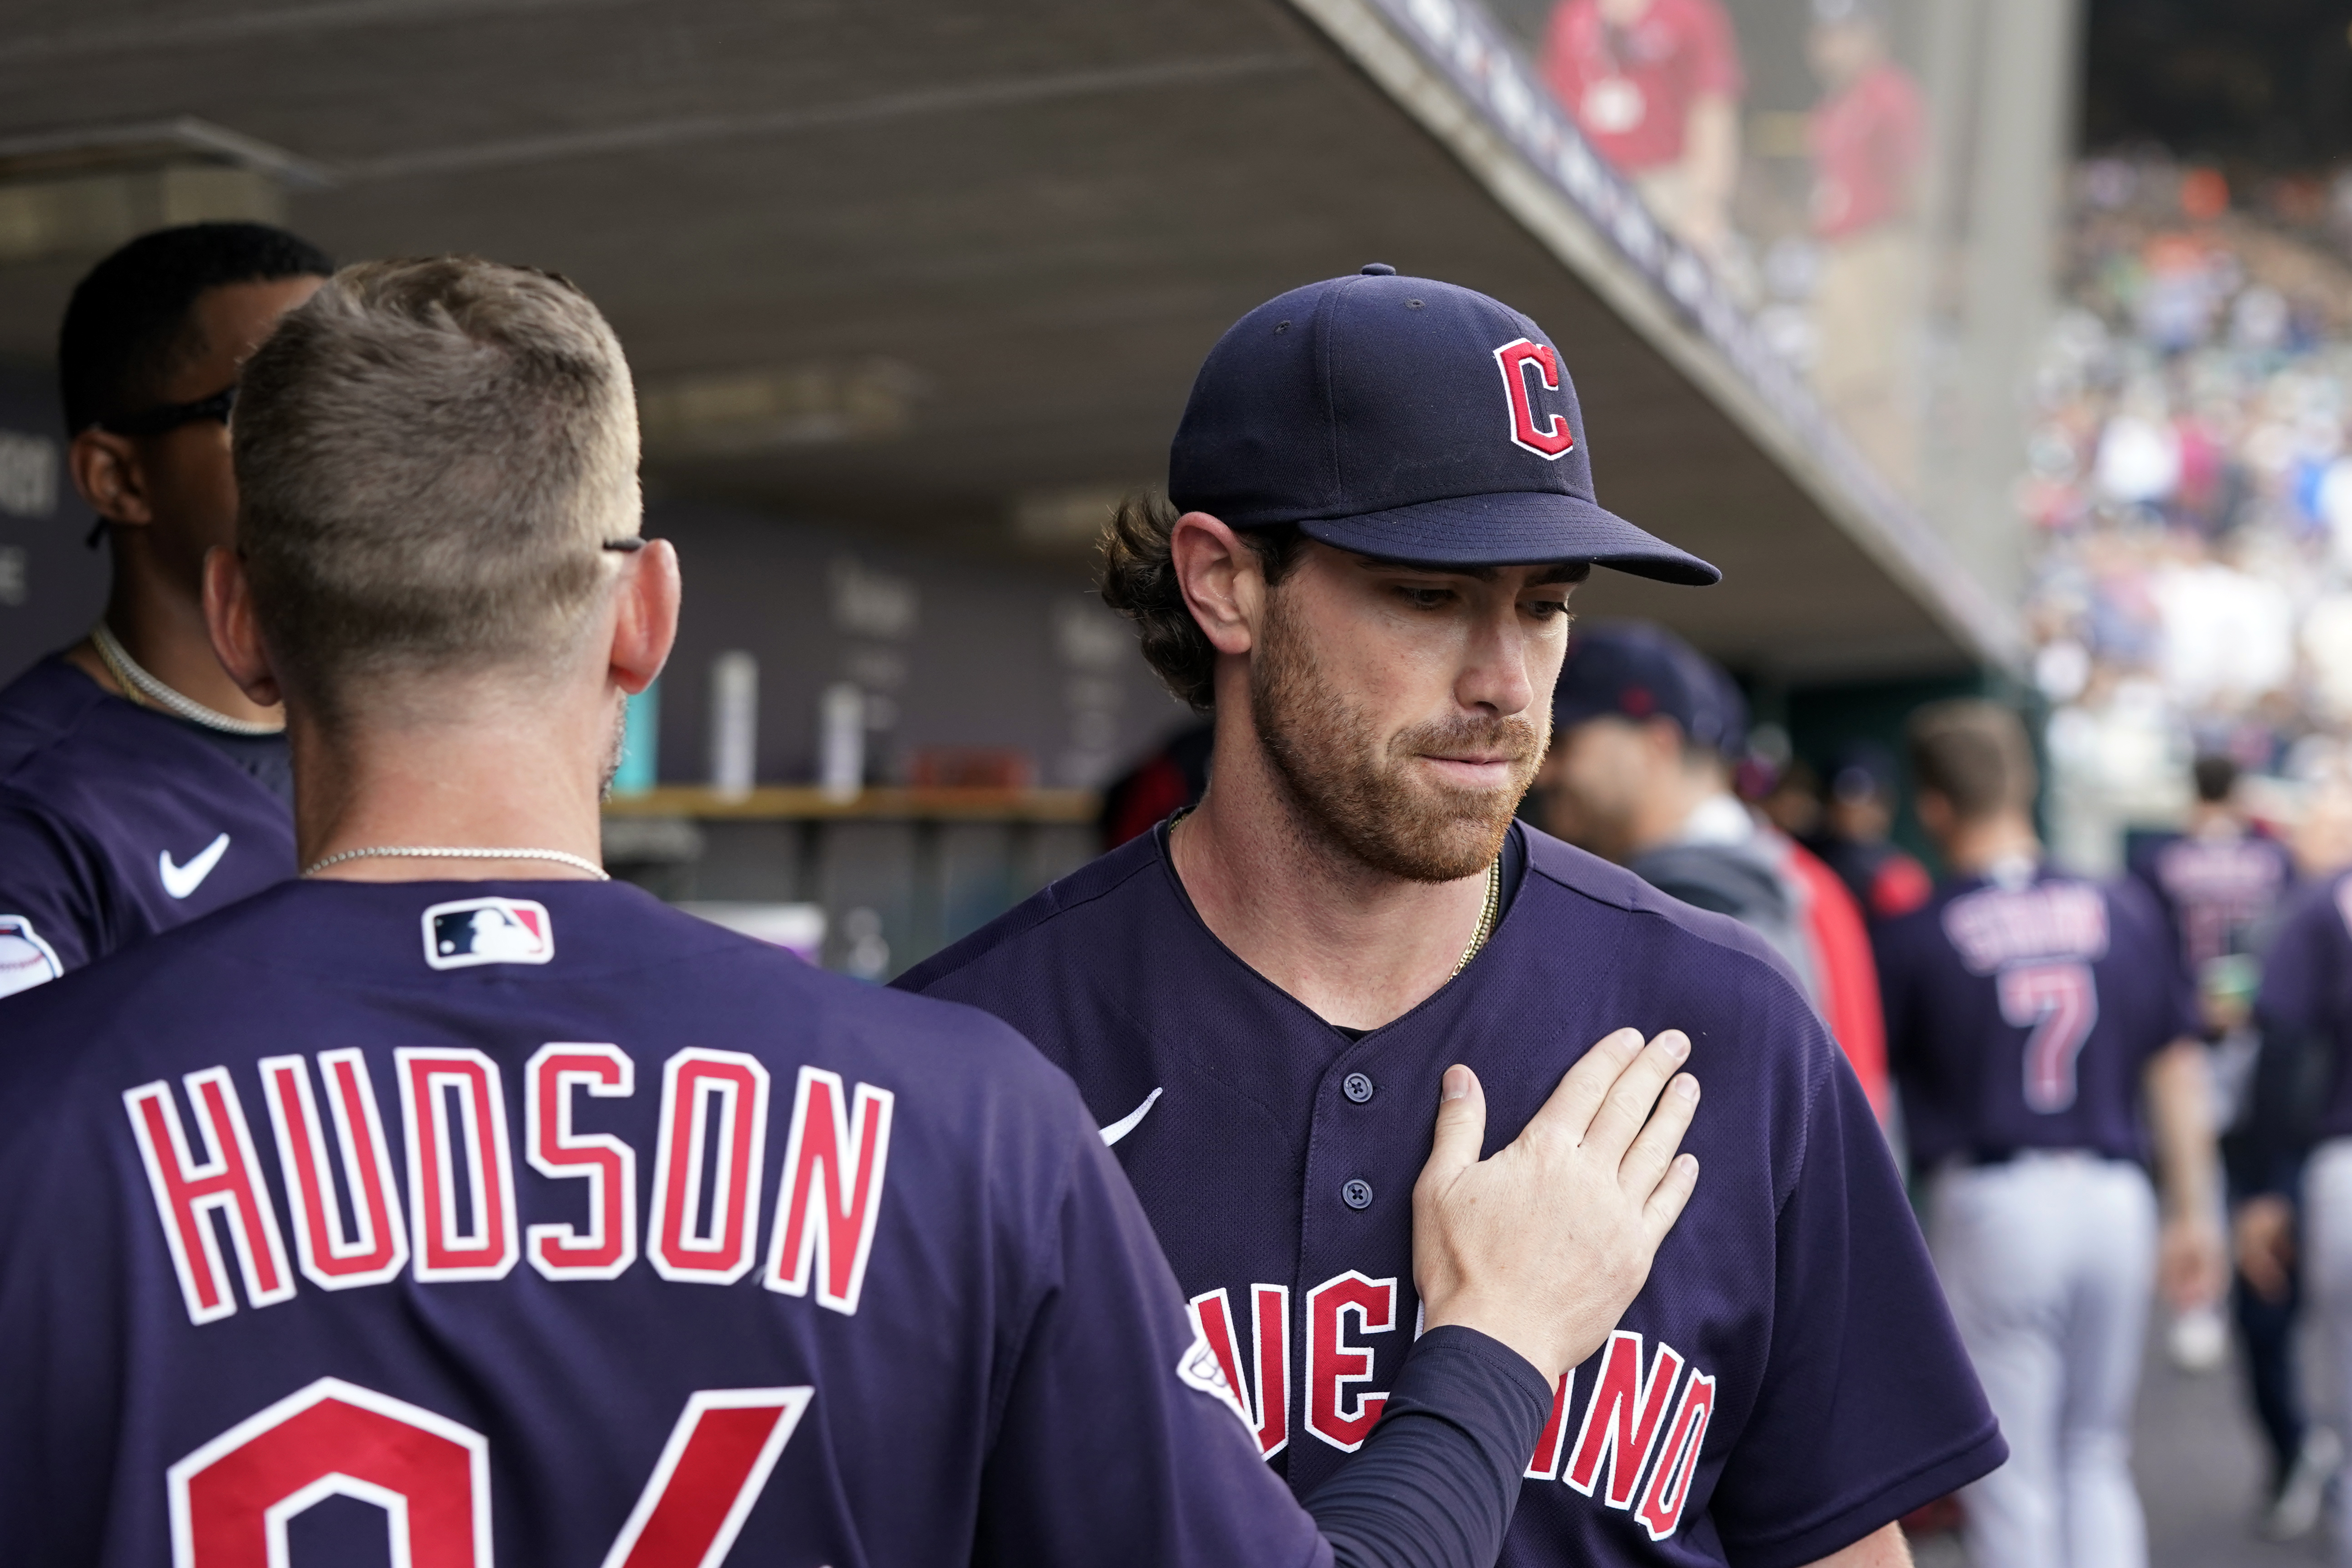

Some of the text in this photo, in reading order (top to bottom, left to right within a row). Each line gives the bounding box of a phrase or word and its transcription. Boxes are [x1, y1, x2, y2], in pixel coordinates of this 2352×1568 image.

[1493, 337, 1574, 461] C
[1996, 961, 2099, 1114] 7
[123, 1042, 894, 1325] HUDSON
